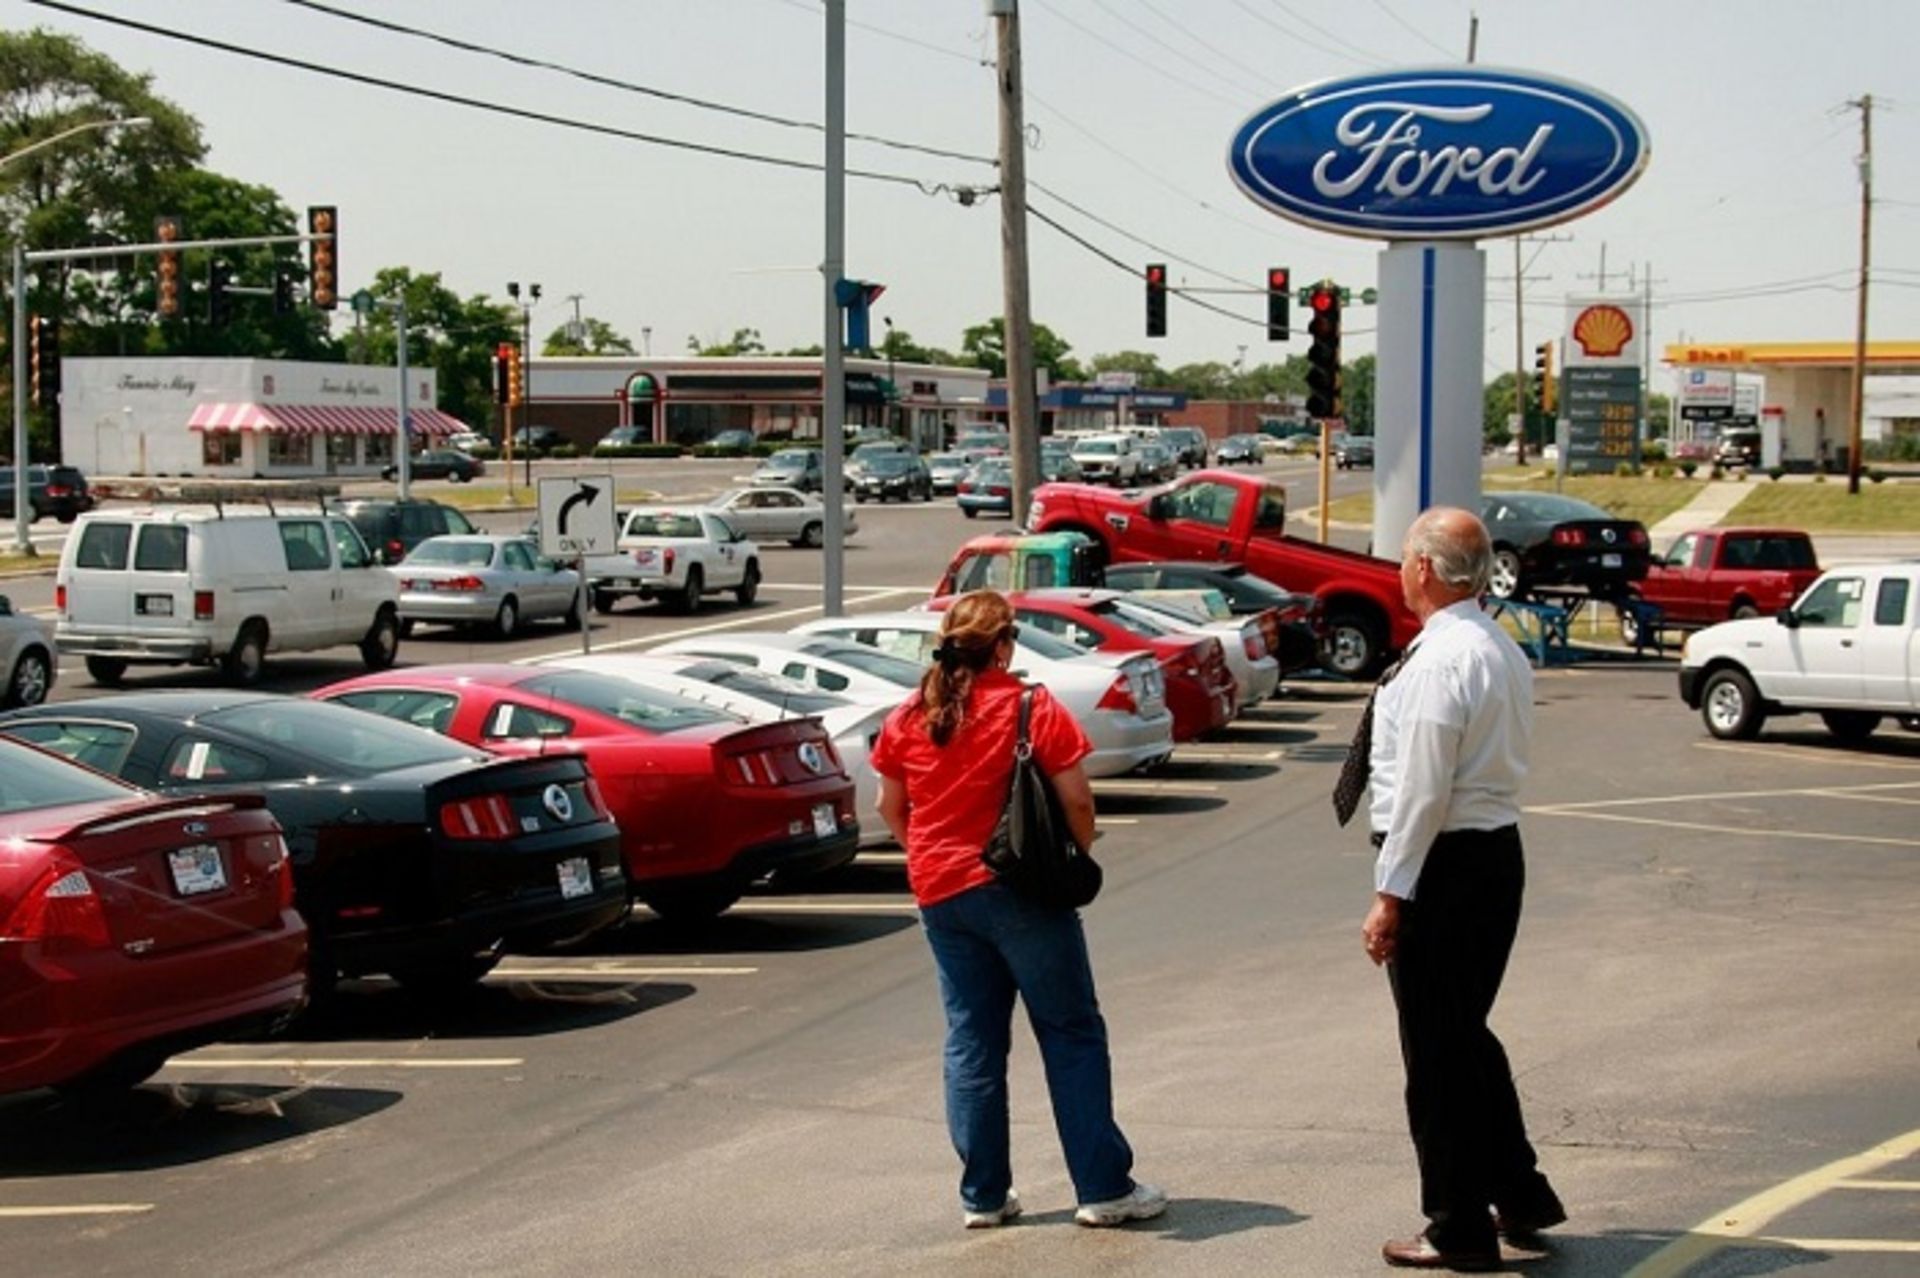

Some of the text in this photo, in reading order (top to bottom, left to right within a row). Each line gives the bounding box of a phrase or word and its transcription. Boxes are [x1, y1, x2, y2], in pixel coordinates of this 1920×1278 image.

[1312, 102, 1555, 198] Ford
[1688, 349, 1744, 363] Shell
[162, 376, 197, 398] May
[559, 538, 596, 552] ONLY
